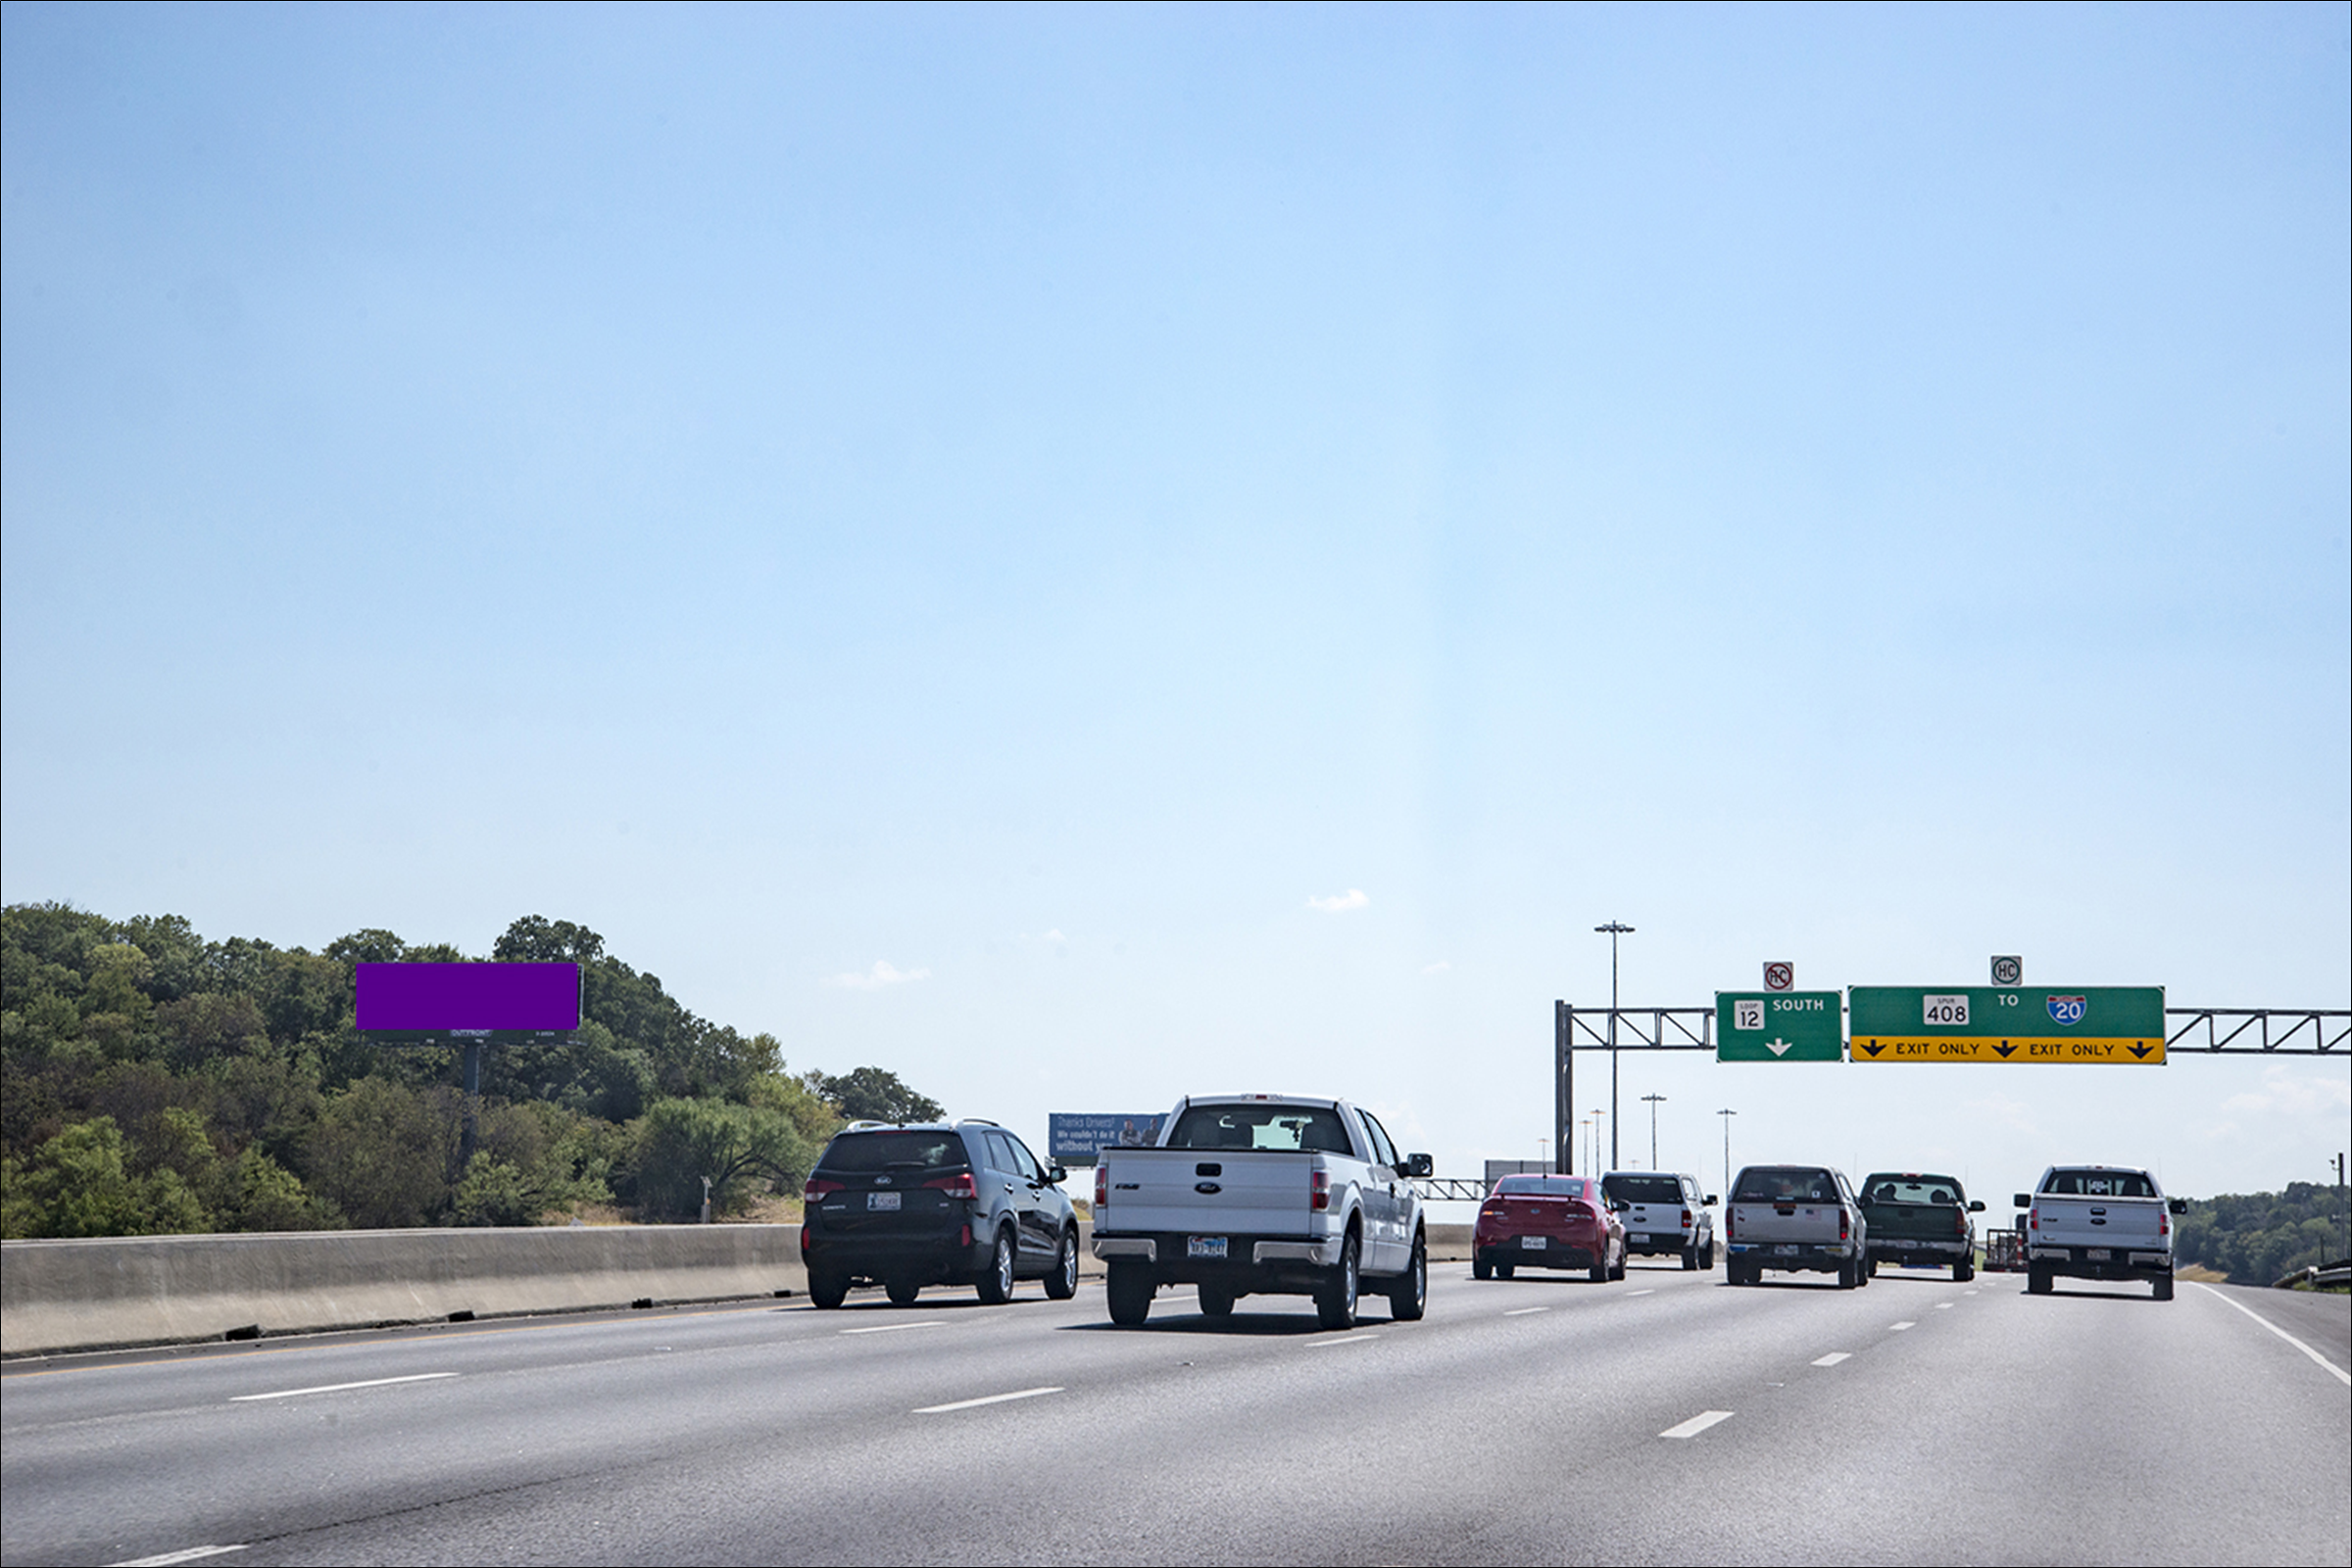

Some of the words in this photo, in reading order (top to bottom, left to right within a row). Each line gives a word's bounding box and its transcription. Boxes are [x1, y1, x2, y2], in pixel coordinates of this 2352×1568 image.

[1770, 969, 1788, 984] HC
[1997, 963, 2017, 978] HC
[1772, 999, 1824, 1011] SOUTH
[1997, 995, 2019, 1006] TO
[1927, 1005, 1967, 1022] 408
[2056, 1002, 2081, 1019] 20
[1740, 1010, 1759, 1027] 12
[1896, 1043, 1930, 1054] EXIT
[1938, 1043, 1980, 1054] ONLY
[2030, 1044, 2063, 1055] EXIT
[2072, 1044, 2115, 1055] ONLY
[1055, 1140, 1094, 1152] without
